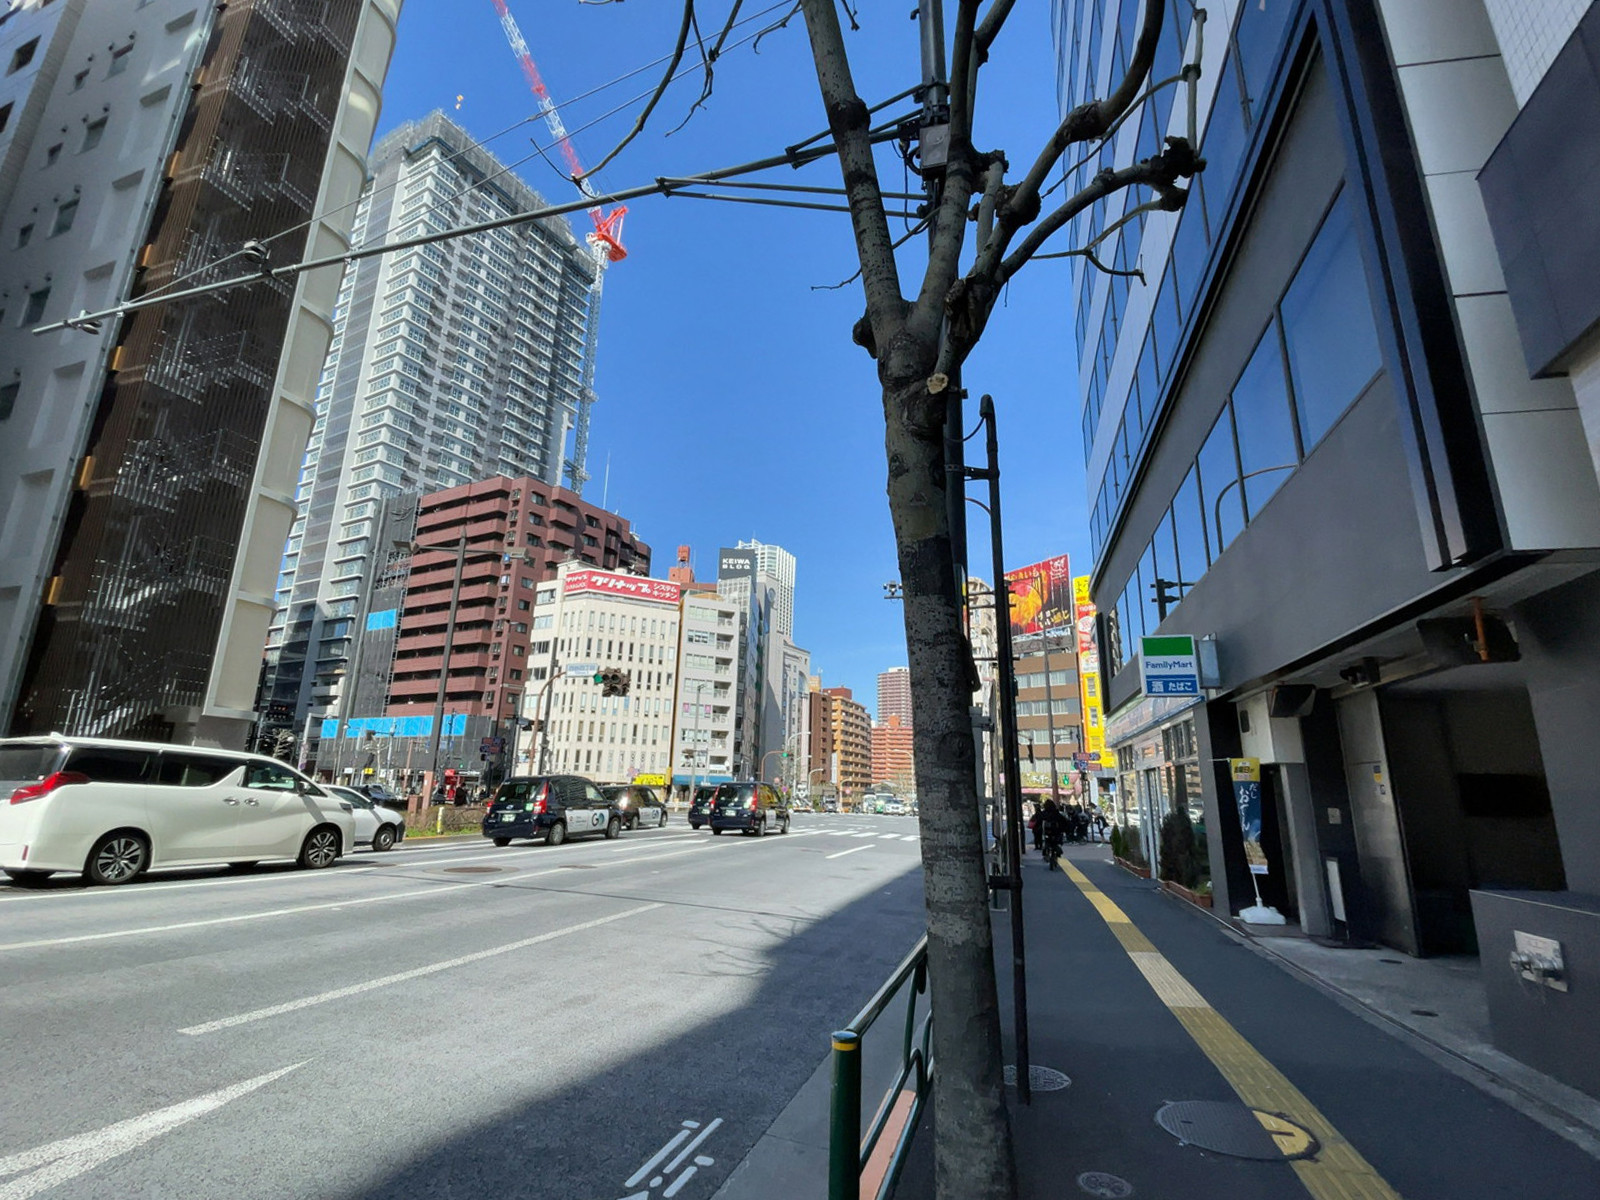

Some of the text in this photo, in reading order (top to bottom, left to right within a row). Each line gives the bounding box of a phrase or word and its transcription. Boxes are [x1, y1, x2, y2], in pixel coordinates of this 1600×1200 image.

[590, 575, 652, 594] クリナップ
[653, 583, 677, 593] システム
[652, 590, 678, 599] キッチン
[1145, 660, 1193, 670] FamilyMart
[1152, 681, 1193, 692] 酒 たばこ
[1239, 785, 1251, 832] おでん
